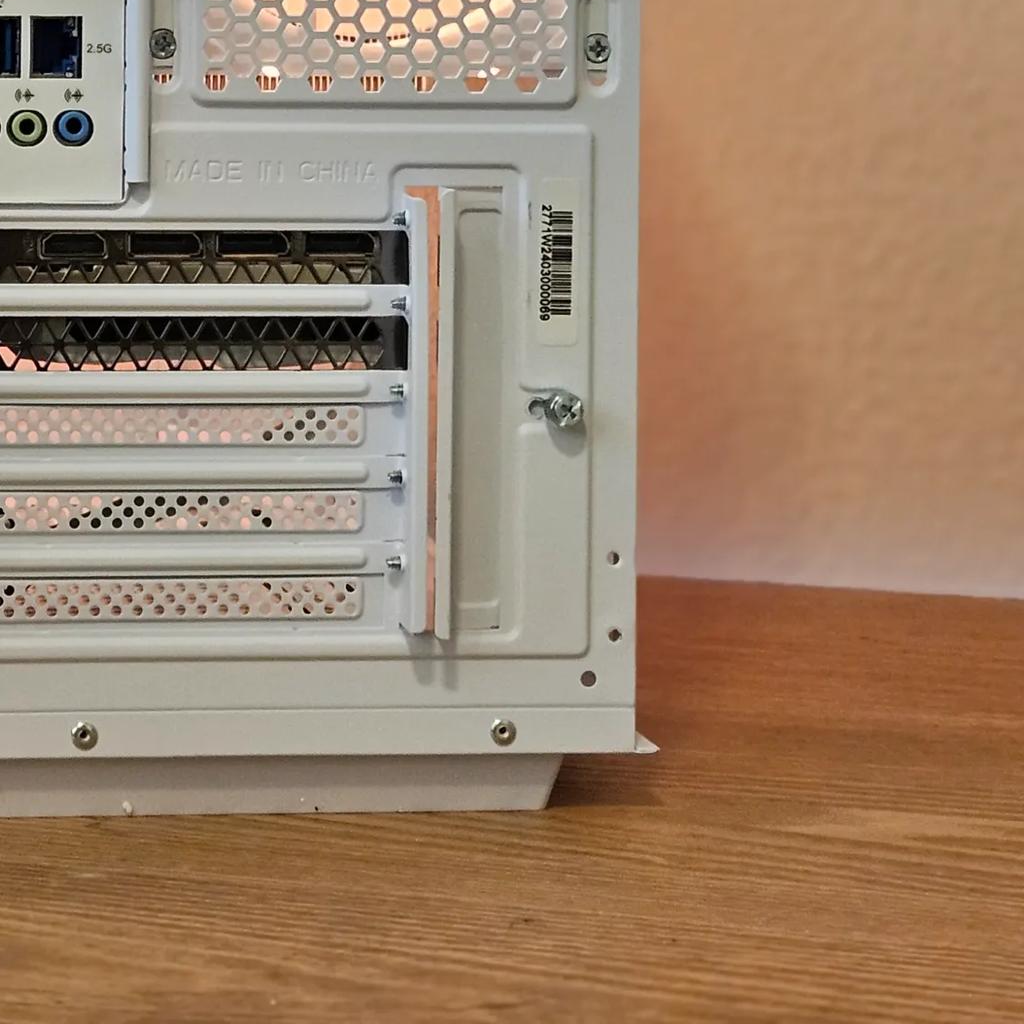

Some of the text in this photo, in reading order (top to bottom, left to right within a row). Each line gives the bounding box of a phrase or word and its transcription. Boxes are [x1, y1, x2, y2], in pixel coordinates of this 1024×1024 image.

[86, 43, 113, 54] 2.5G
[165, 159, 378, 183] MADE IN CHINA
[539, 204, 553, 322] 2771W2403000069
